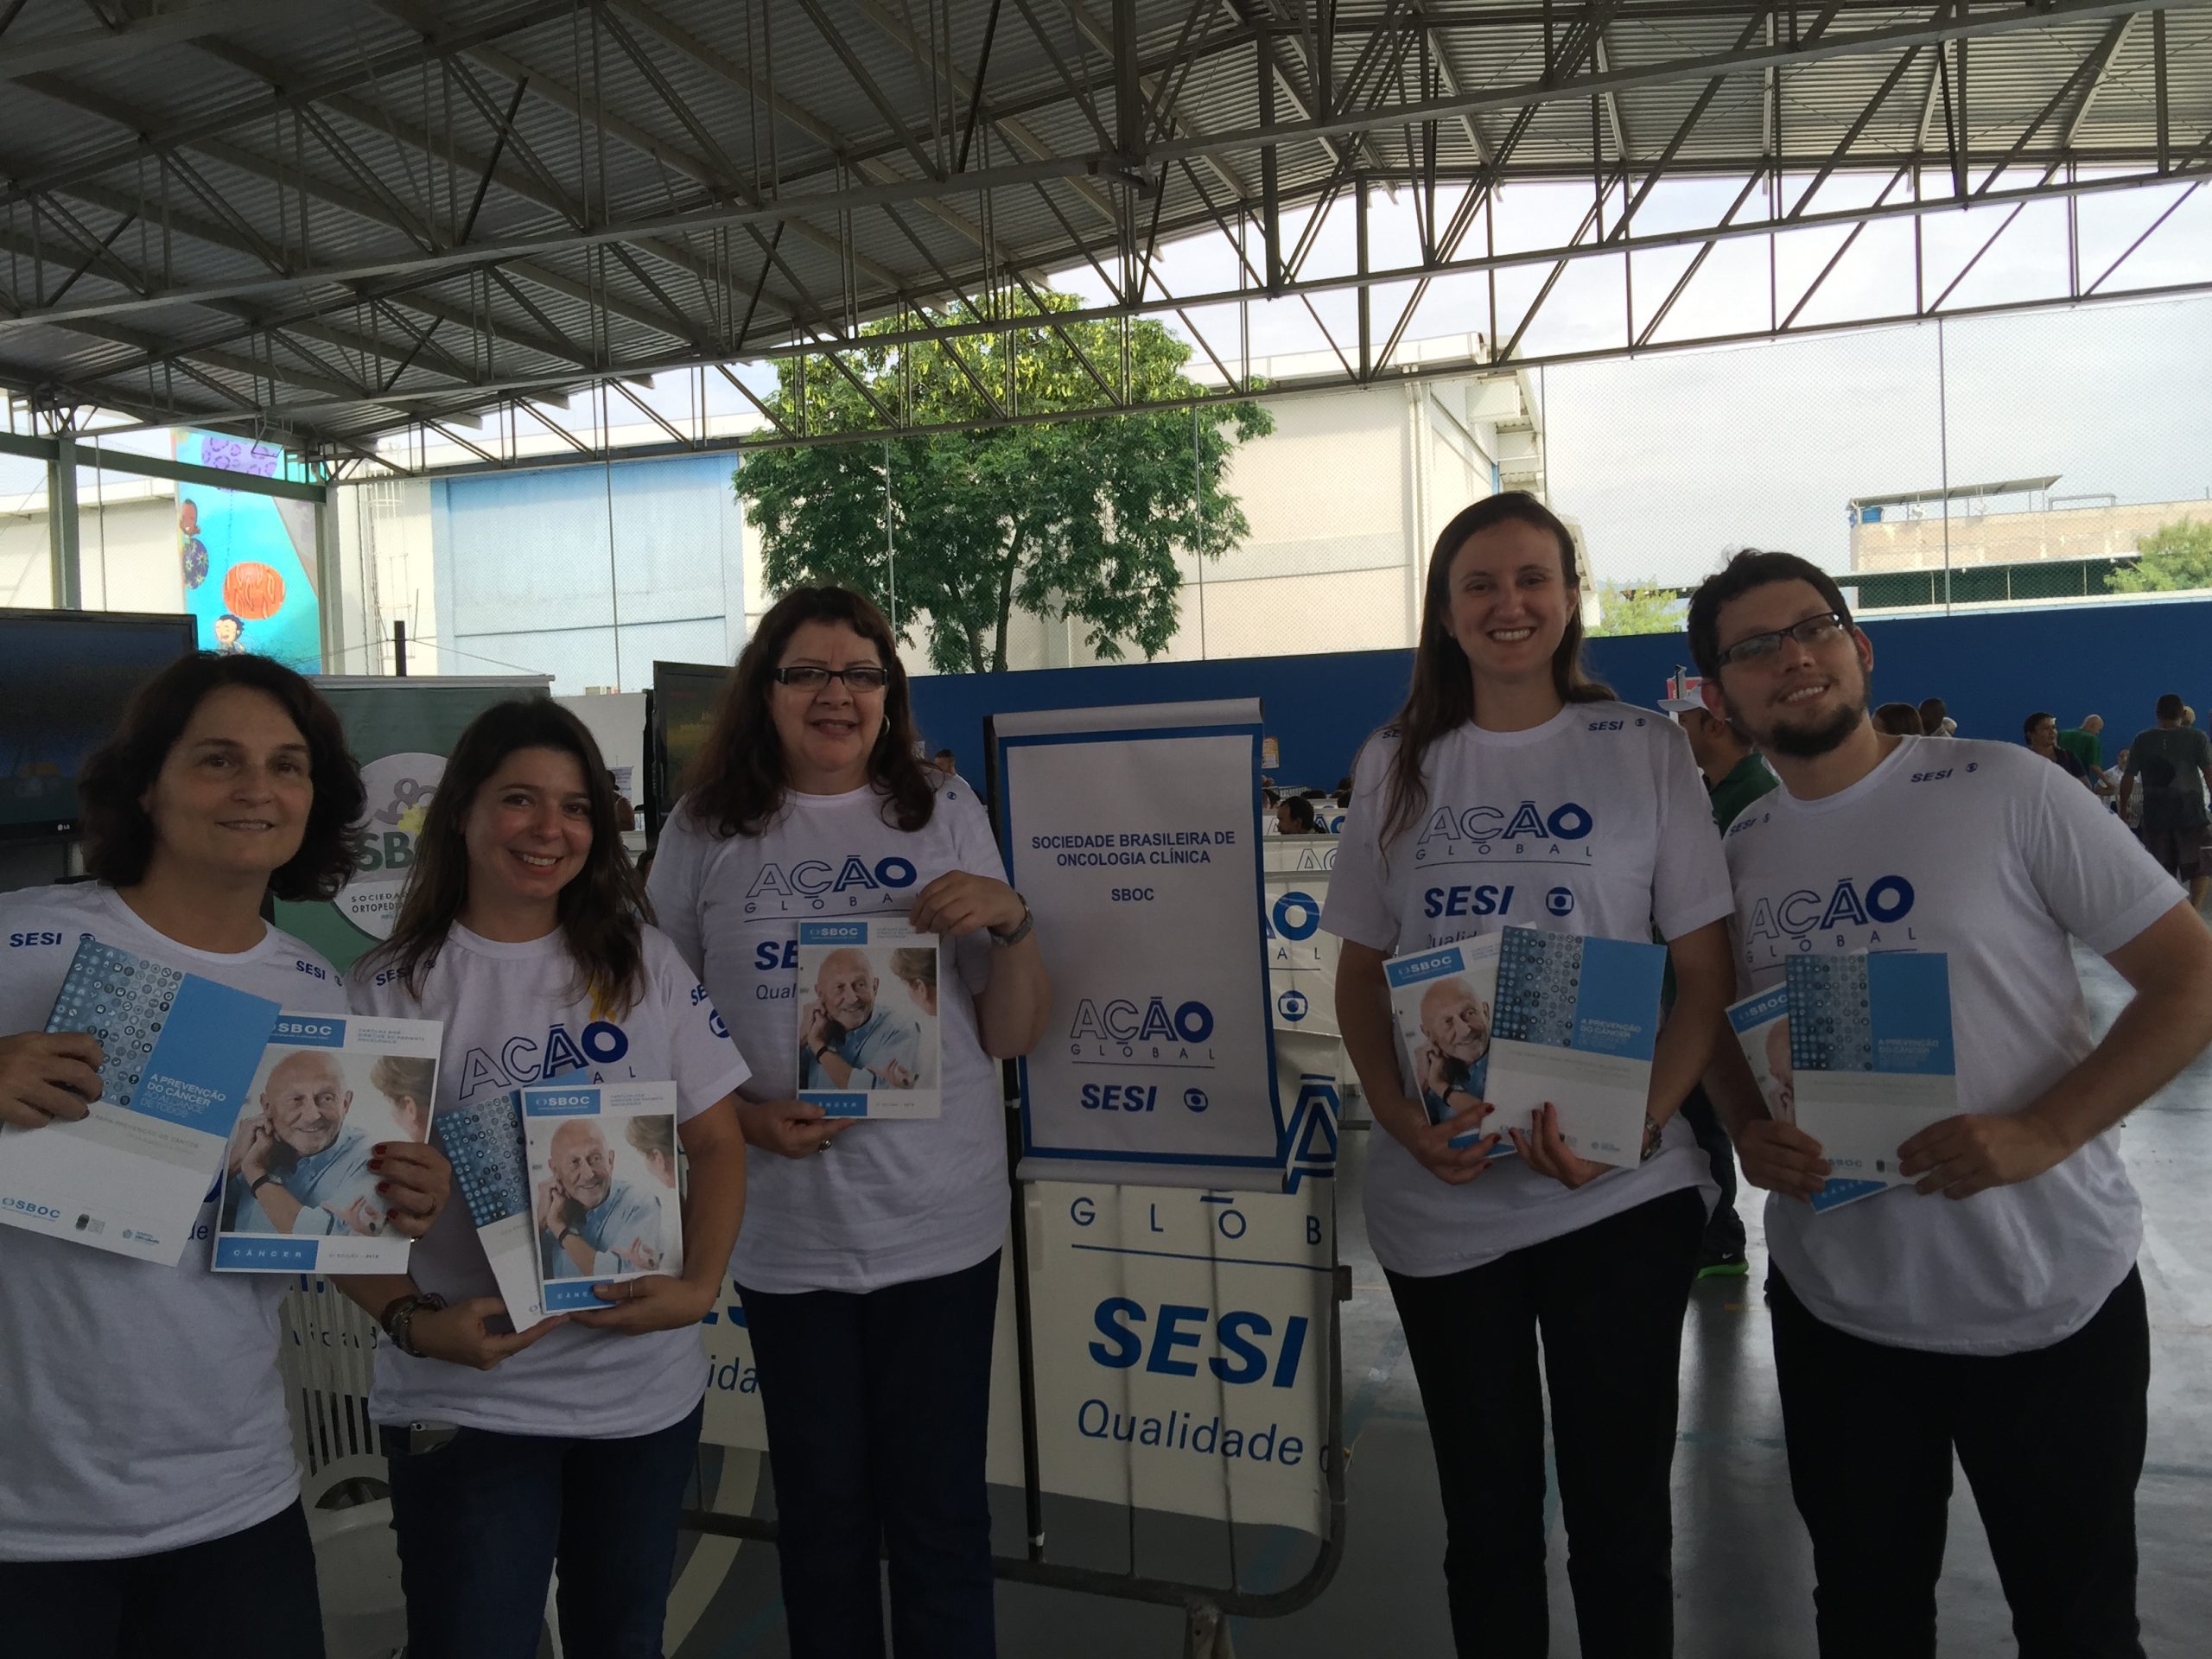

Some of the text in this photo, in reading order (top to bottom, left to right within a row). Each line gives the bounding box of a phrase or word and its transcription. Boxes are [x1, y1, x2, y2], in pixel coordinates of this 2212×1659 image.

[1588, 721, 1623, 732] SESI
[1910, 769, 1953, 783] SESI
[1032, 831, 1236, 849] SOCIEDADE BRASILEIRA DE
[1057, 848, 1211, 866] ONCOLOGIA CLÍNICA
[1415, 843, 1591, 860] GLOBAL
[1111, 888, 1154, 901] SBOC
[1423, 884, 1515, 918] SESI
[10, 932, 62, 948] SESI
[296, 960, 326, 980] SESI
[1071, 1044, 1215, 1059] GLOBAL
[146, 1082, 164, 1093] DO
[150, 1073, 226, 1102] A PREVENÇÃO
[1080, 1084, 1157, 1112] SESI
[1089, 1296, 1308, 1389] SESI
[1078, 1398, 1304, 1465] Qualidade
